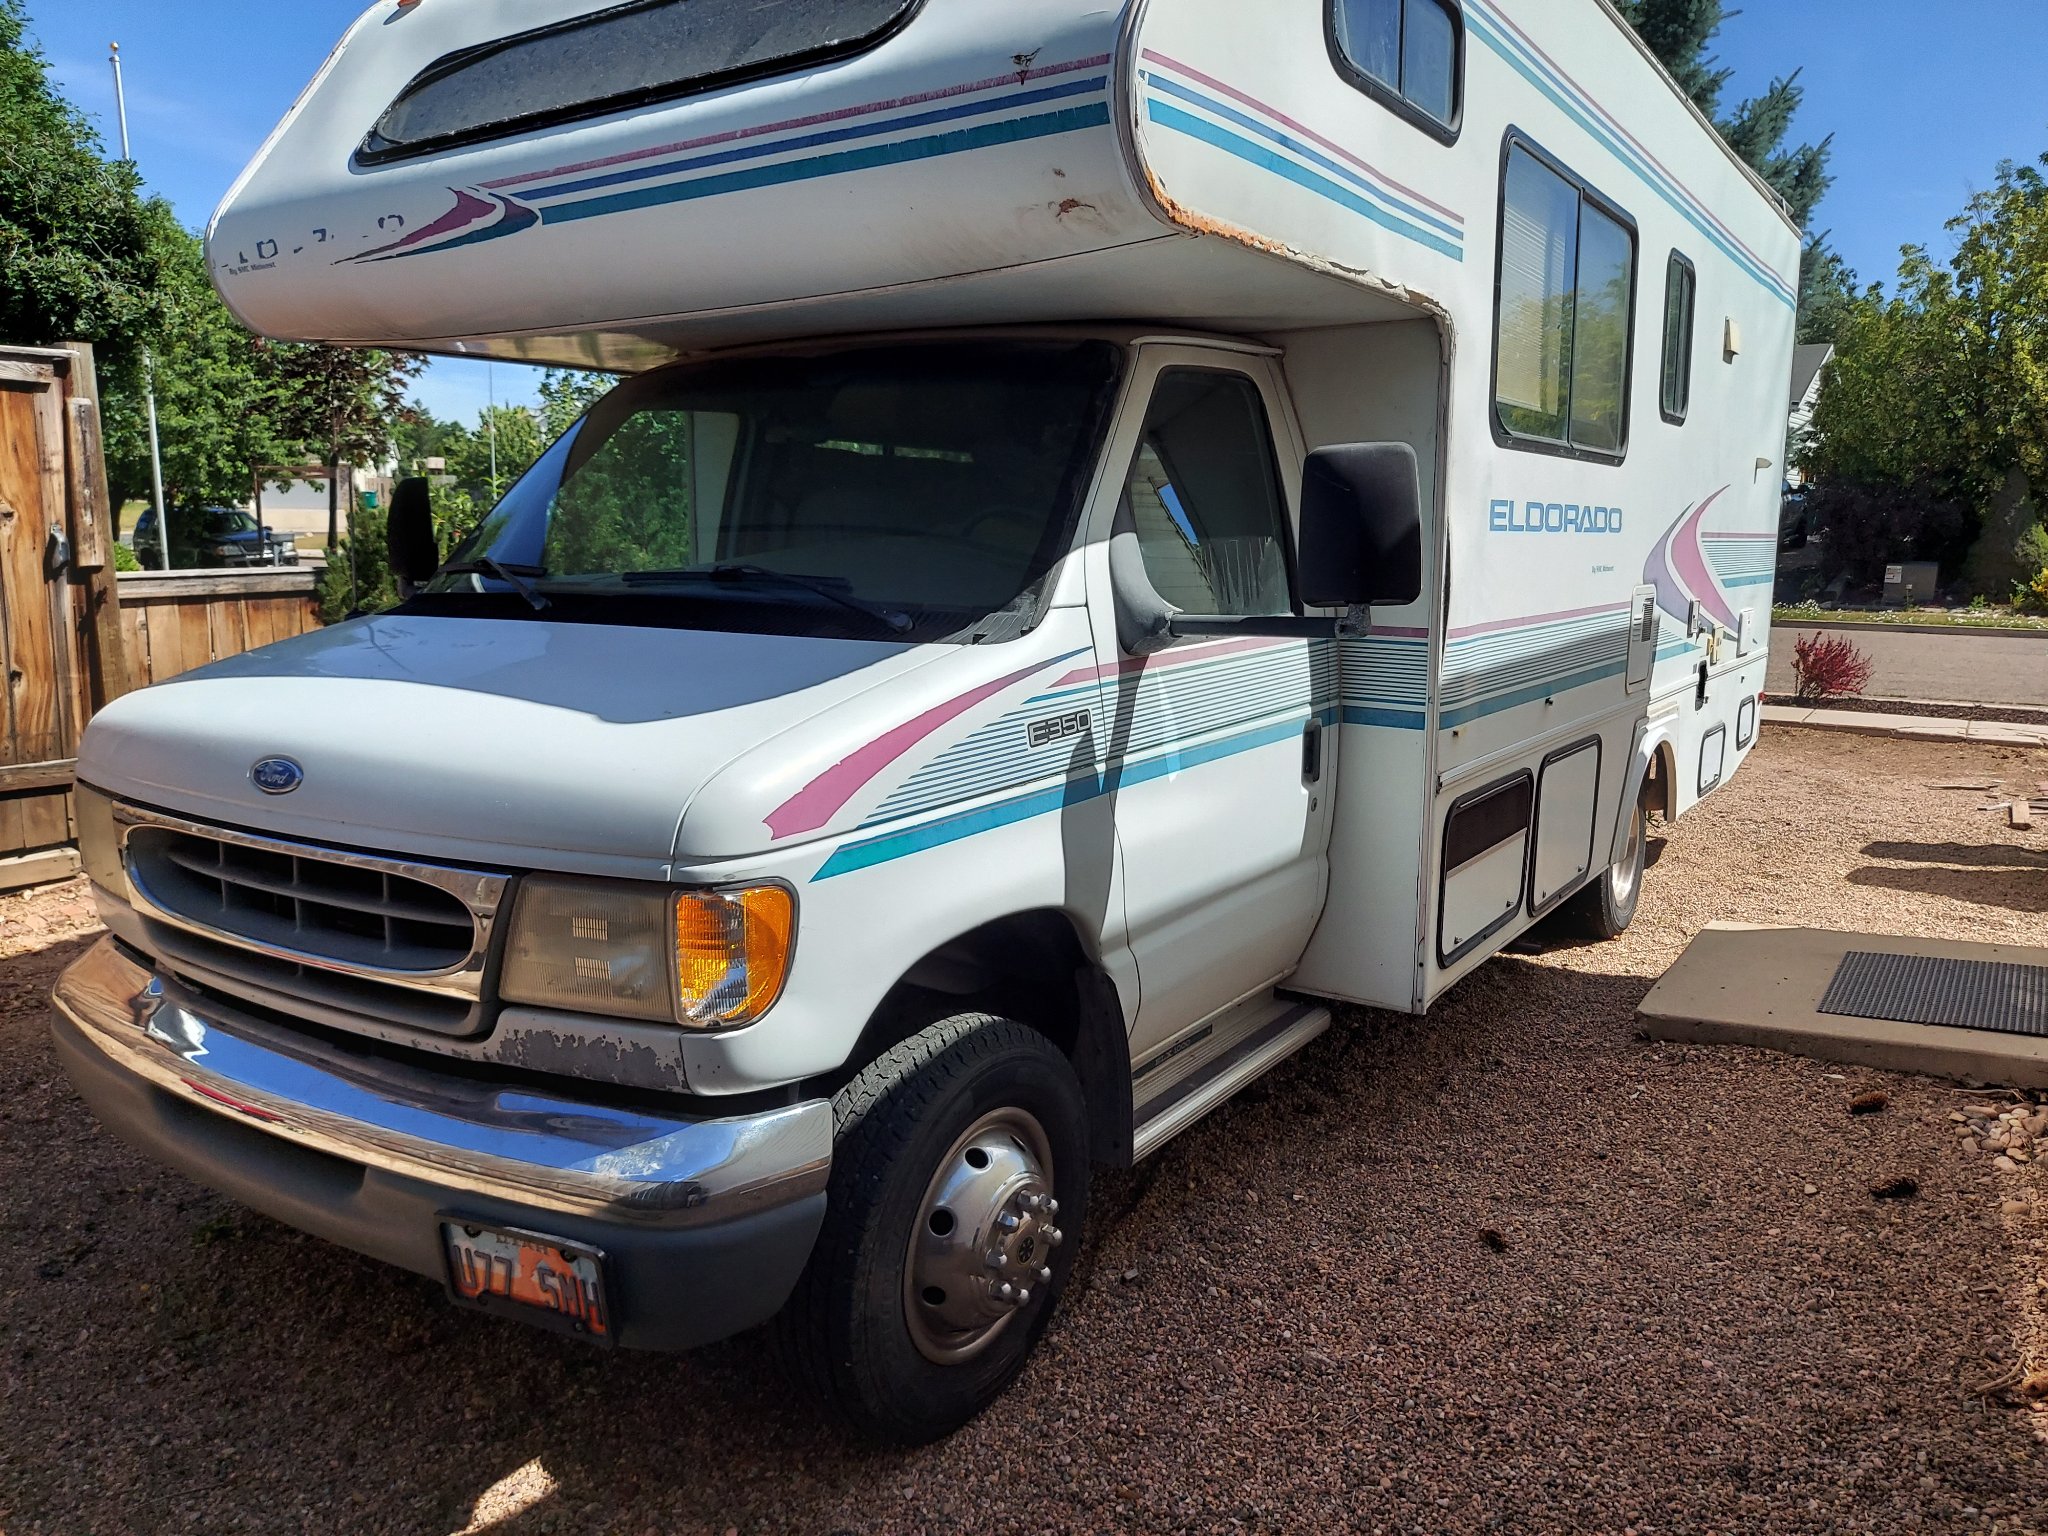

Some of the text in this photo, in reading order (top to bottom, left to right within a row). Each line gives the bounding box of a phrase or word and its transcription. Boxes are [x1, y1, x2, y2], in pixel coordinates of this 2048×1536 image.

[1489, 499, 1622, 533] ELDORADO
[258, 766, 289, 784] Ford
[453, 1244, 512, 1296] U77
